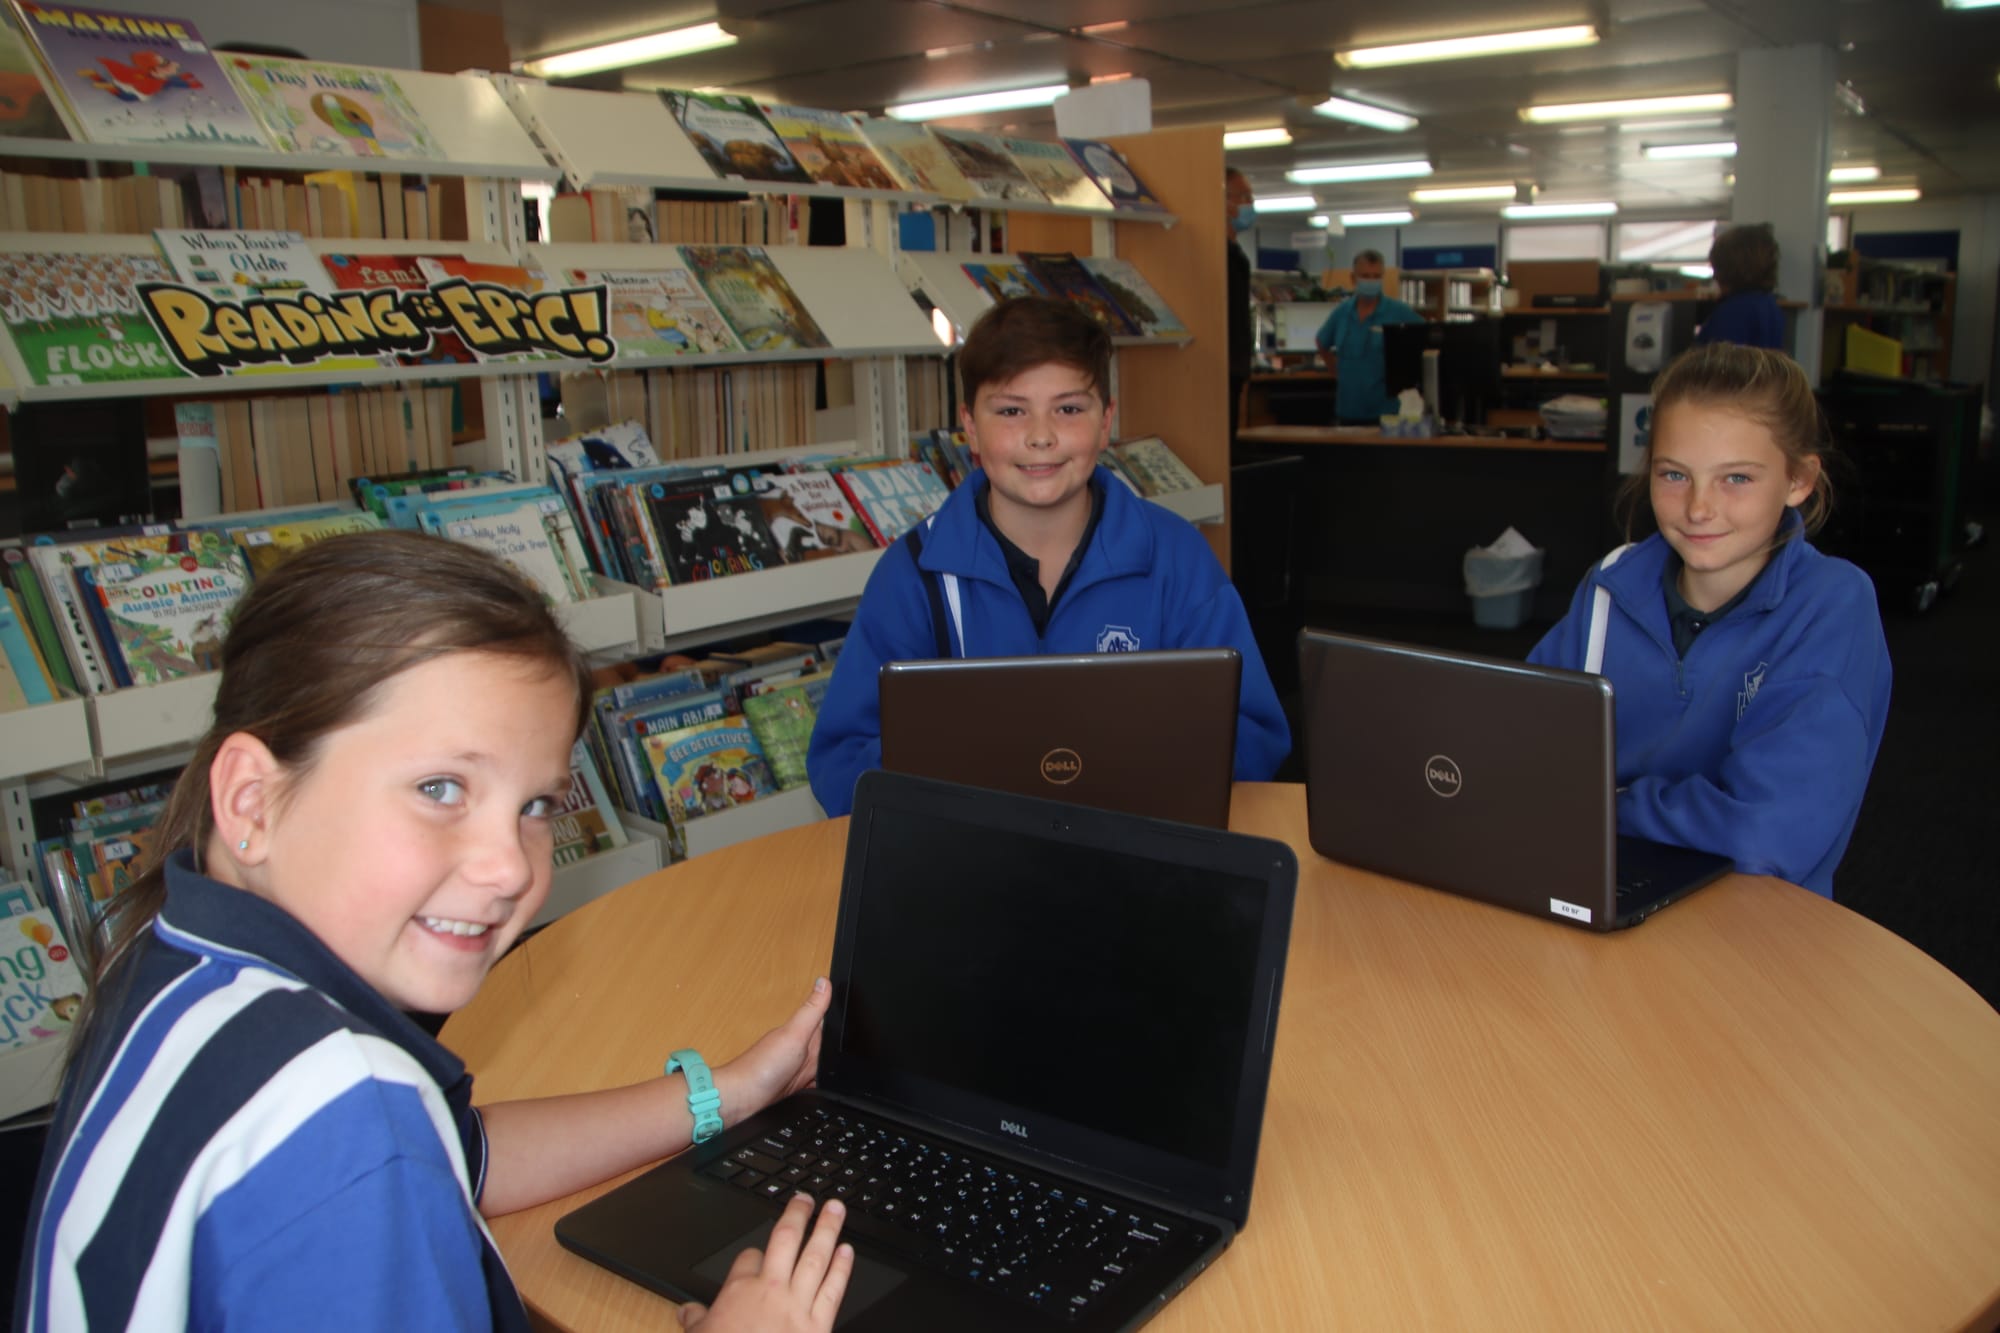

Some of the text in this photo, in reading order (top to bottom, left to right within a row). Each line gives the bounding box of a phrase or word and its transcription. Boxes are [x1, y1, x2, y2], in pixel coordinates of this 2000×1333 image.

[34, 8, 190, 40] MAXINE
[180, 232, 289, 250] When You're
[229, 252, 288, 272] Older
[848, 466, 925, 499] A DAY
[129, 575, 226, 600] COUNTING
[122, 596, 175, 614] Aussie
[646, 716, 680, 735] MAIN
[1045, 760, 1078, 773] DELL
[1429, 767, 1458, 785] DELL
[1000, 1119, 1028, 1138] DELL
